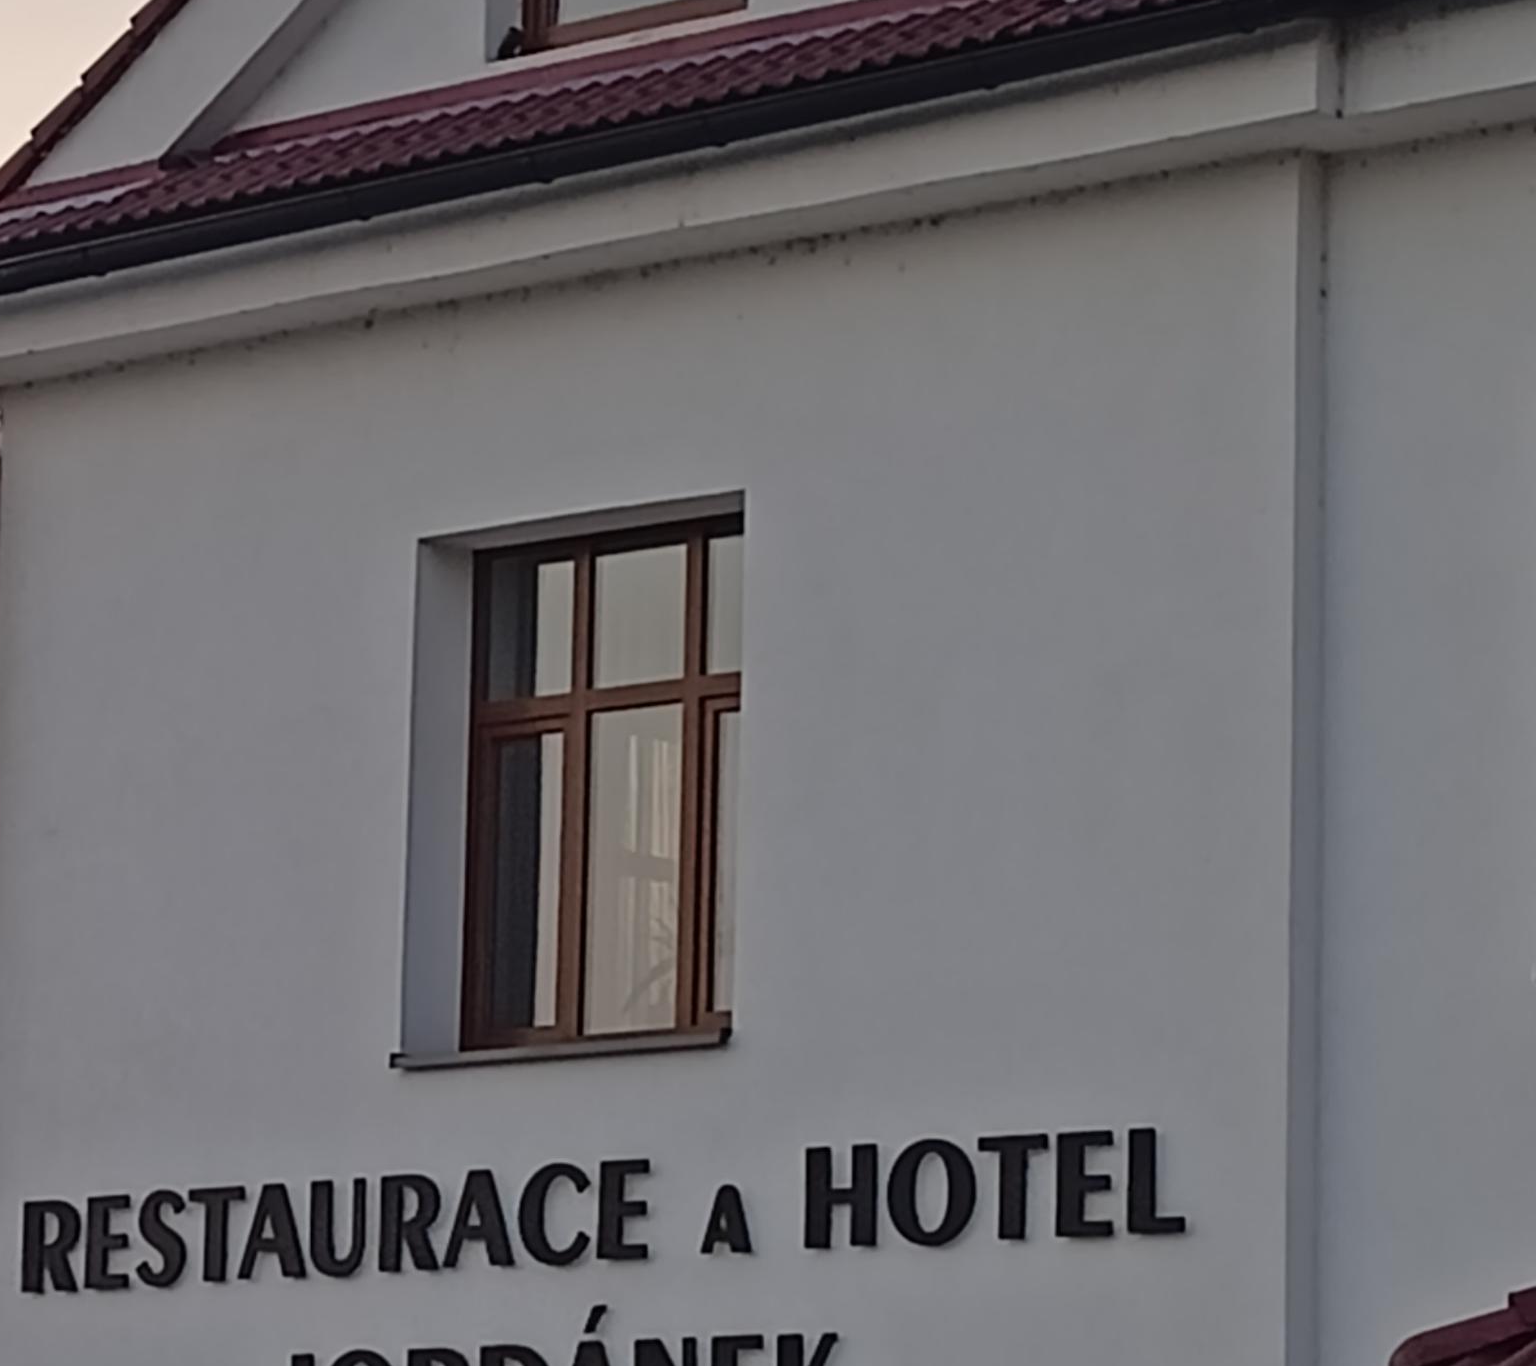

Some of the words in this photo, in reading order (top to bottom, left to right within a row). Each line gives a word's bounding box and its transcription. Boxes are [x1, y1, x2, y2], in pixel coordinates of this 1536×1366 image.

[20, 1158, 652, 1295] RESTAURACE
[700, 1183, 755, 1256] A
[803, 1127, 1187, 1251] HOTEL
